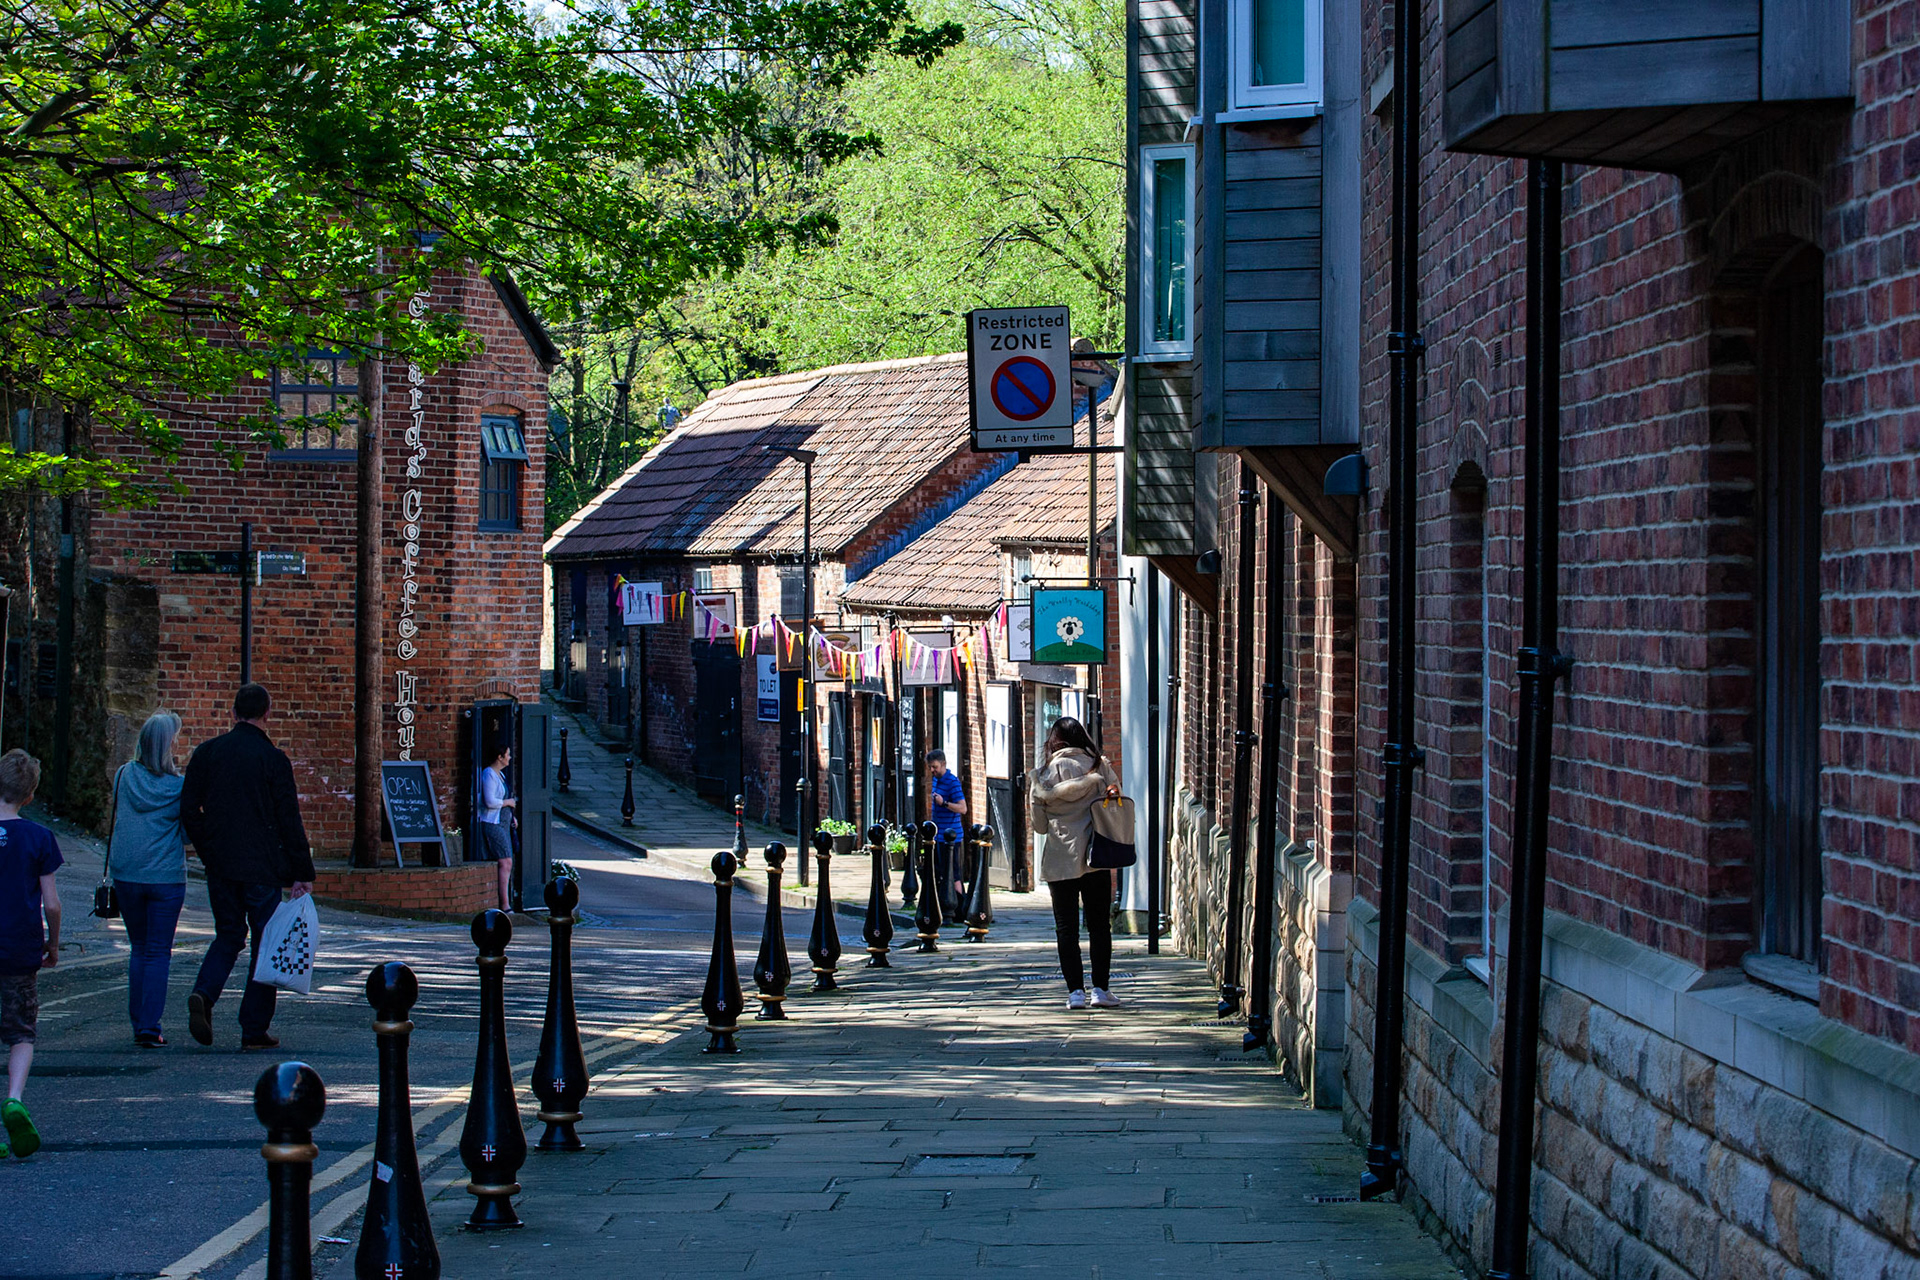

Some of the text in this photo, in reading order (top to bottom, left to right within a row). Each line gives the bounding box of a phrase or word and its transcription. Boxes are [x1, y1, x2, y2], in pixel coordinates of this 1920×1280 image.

[978, 313, 1065, 330] Restricted
[990, 333, 1052, 351] ZONE
[995, 433, 1056, 444] At any time
[397, 488, 423, 661] Coffee
[1037, 605, 1049, 615] The
[759, 679, 777, 693] TO LET
[394, 670, 418, 762] Hous
[387, 777, 421, 796] OPEN
